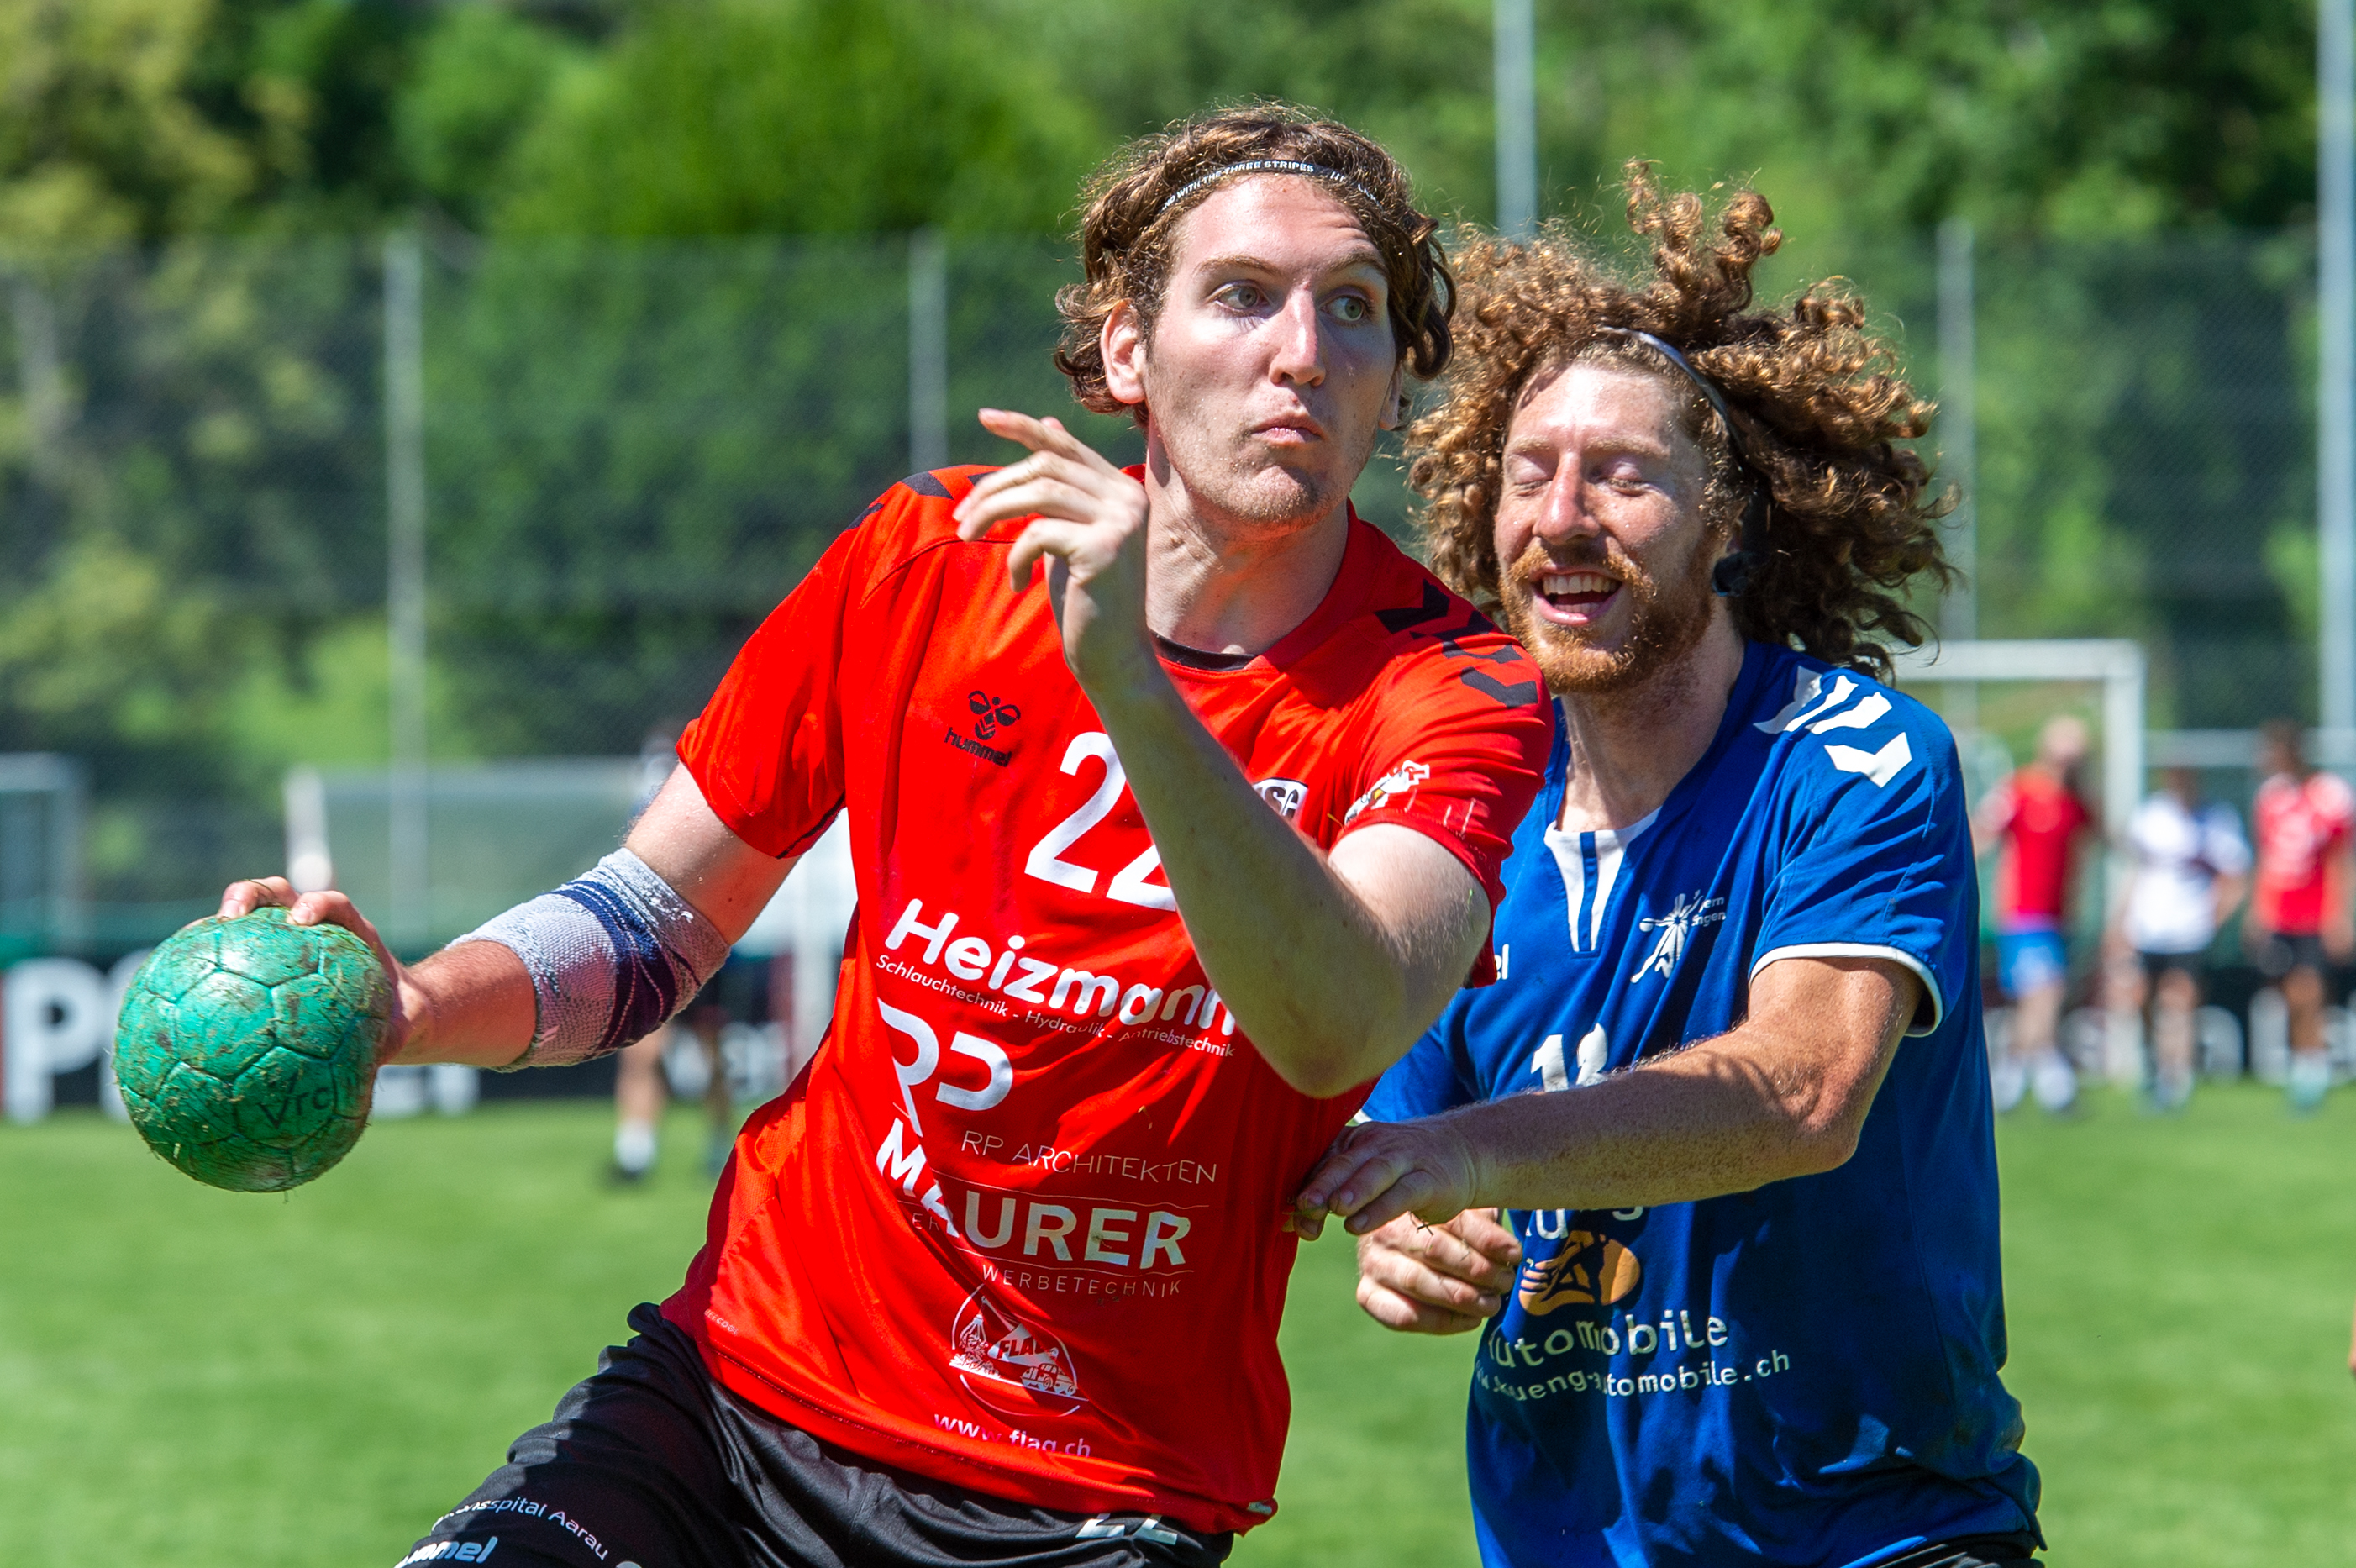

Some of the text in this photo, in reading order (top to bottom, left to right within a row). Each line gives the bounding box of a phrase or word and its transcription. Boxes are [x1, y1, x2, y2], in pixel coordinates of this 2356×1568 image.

[1176, 180, 1201, 198] WITH
[1202, 170, 1223, 184] THE
[1224, 160, 1261, 175] THREE
[1264, 160, 1315, 173] STRIPES
[944, 727, 1013, 768] hummel
[884, 898, 1236, 1037] Heizmann
[876, 954, 1008, 1018] Schlauchtechnik
[1024, 1009, 1105, 1039] Hydraulik
[1118, 1027, 1236, 1057] Antriebstechnik
[961, 1130, 1217, 1185] RP ARCHITEKTEN
[982, 1263, 1181, 1298] WERBETECHNIK
[548, 1511, 608, 1561] Aarau
